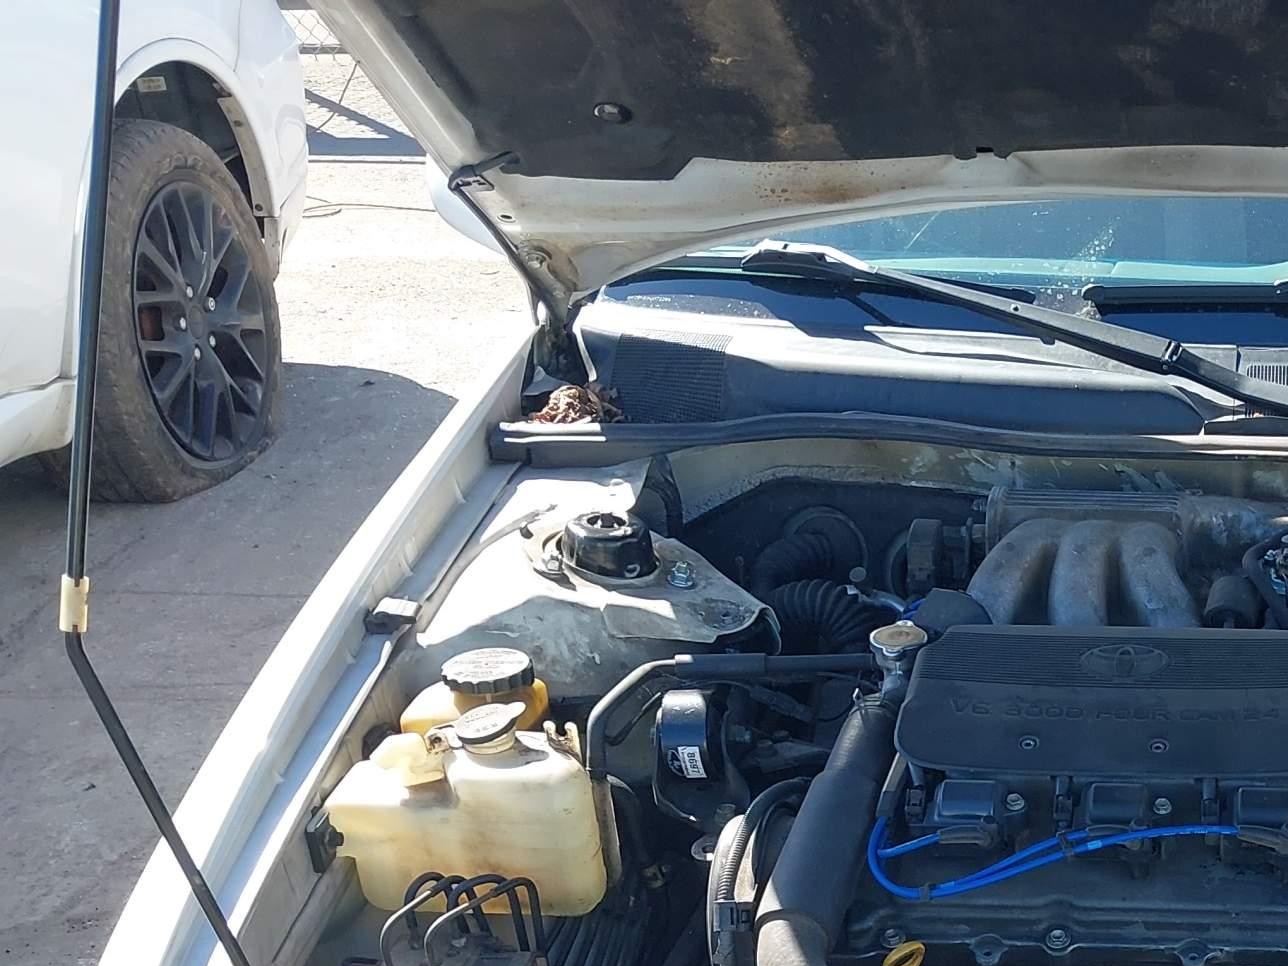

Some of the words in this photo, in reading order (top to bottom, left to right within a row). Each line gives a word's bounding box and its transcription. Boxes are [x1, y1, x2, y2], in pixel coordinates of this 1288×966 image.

[949, 696, 992, 716] V6
[1095, 702, 1171, 721] FOUR
[1178, 706, 1236, 721] CAM
[1243, 706, 1281, 721] 24
